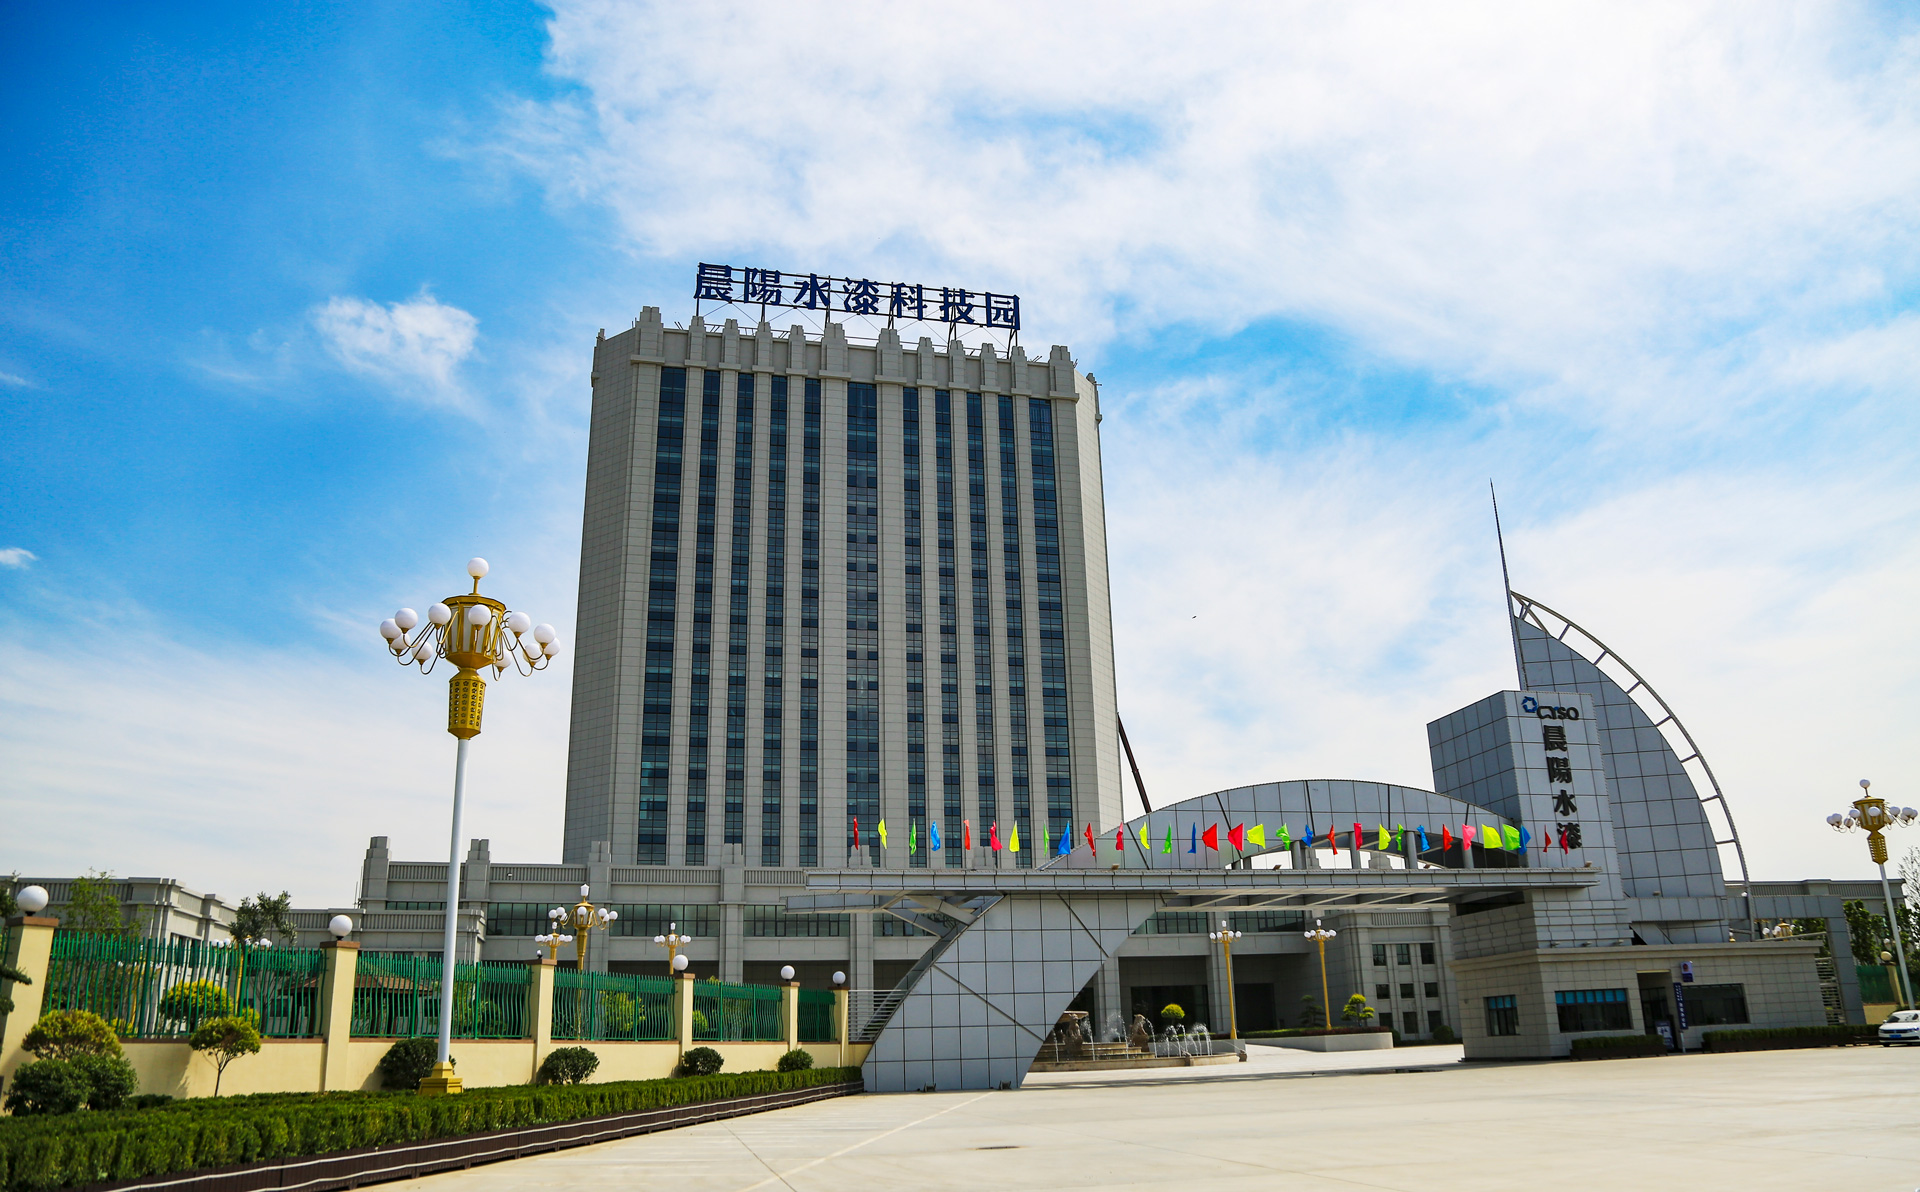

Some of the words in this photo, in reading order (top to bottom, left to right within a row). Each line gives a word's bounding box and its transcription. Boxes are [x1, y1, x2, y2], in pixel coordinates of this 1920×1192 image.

[694, 262, 1020, 330] 晨陽水漆科技园
[1543, 725, 1583, 850] 晨陽水漆
